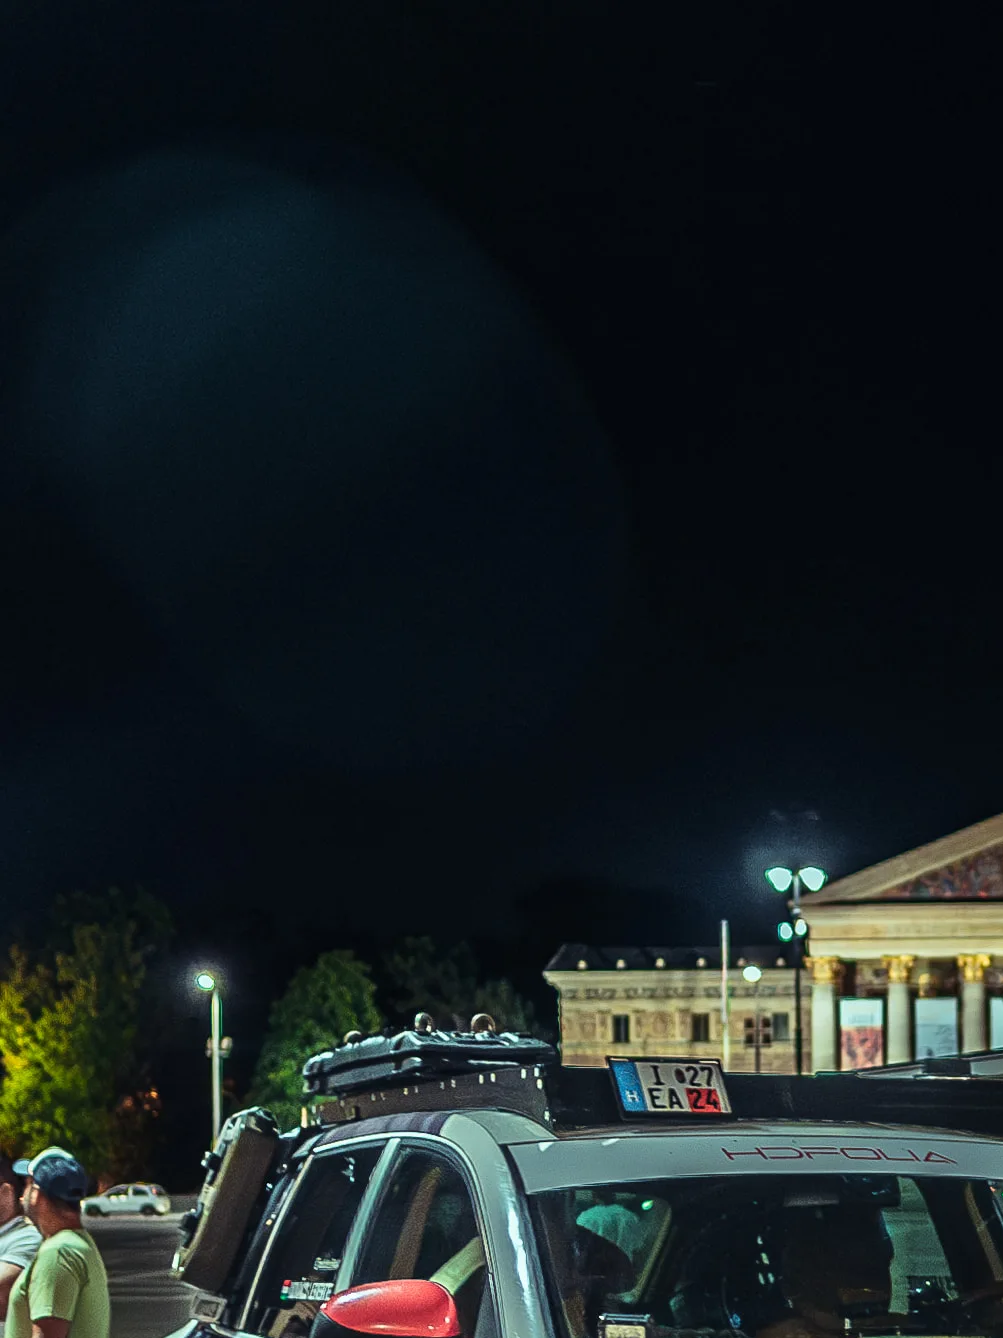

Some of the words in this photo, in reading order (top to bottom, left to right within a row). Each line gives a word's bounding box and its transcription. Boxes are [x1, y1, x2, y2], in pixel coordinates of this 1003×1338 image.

[685, 1066, 713, 1086] 27
[625, 1090, 639, 1102] H
[648, 1088, 684, 1109] EA
[689, 1089, 718, 1109] 24
